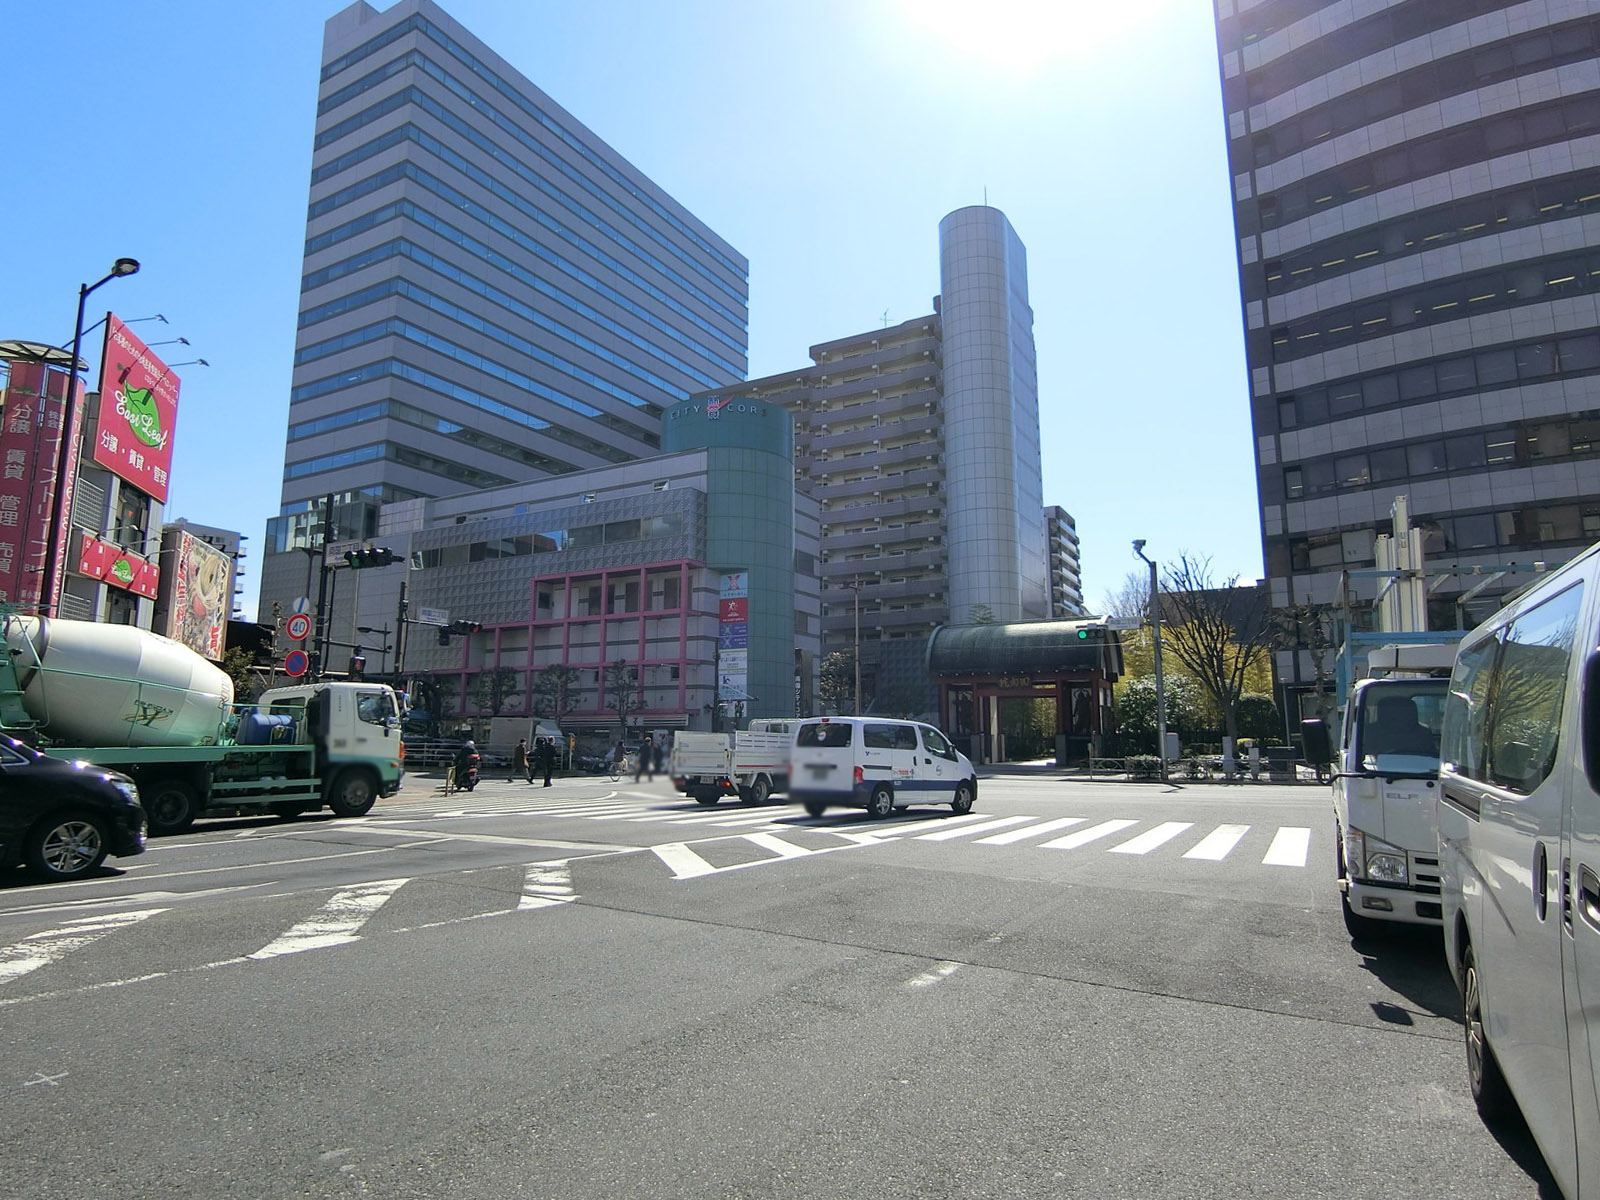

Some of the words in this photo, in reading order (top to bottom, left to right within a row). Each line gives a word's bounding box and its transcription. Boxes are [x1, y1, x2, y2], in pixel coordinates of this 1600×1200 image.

[9, 403, 33, 435] 分譲
[670, 405, 701, 420] CITY
[3, 448, 27, 481] 賃貸
[0, 494, 21, 527] 管理
[292, 621, 306, 633] 40
